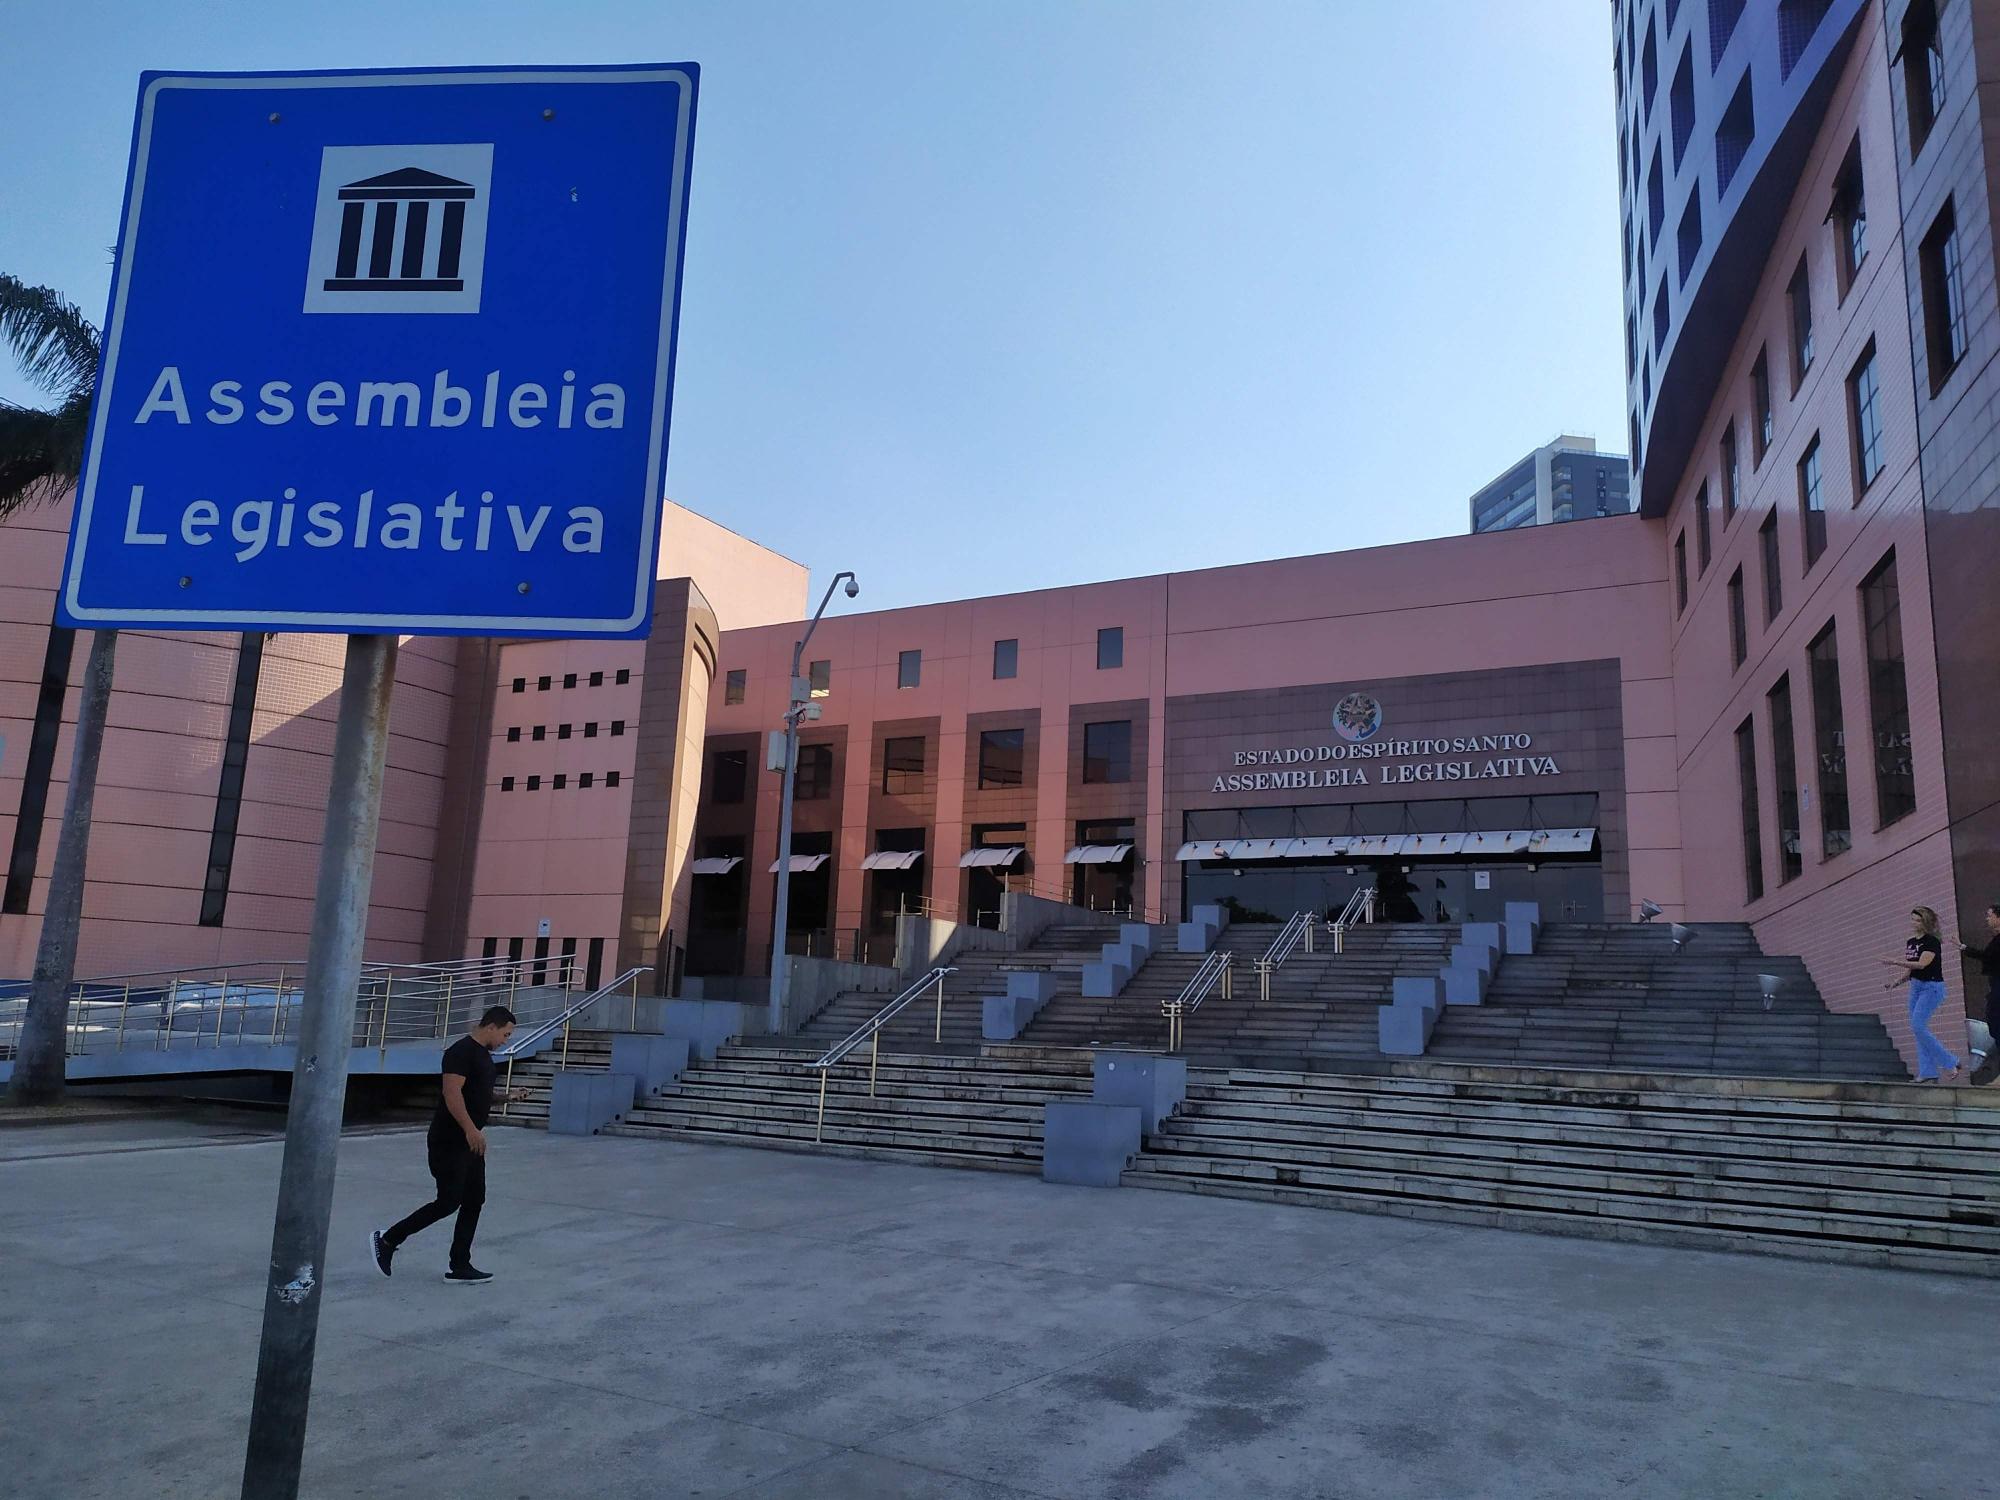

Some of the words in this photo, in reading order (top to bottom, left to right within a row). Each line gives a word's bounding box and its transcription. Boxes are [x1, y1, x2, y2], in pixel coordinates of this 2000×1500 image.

[134, 366, 627, 430] Assembleia
[123, 485, 604, 563] Legislativa
[1211, 767, 1369, 793] ASSEMBLEIA
[1380, 757, 1561, 784] LEGISLATIVA
[1234, 748, 1315, 767] ESTADO
[1316, 745, 1346, 762] DO
[1347, 737, 1450, 759] ESPÍRITO
[1452, 733, 1531, 753] SANTO
